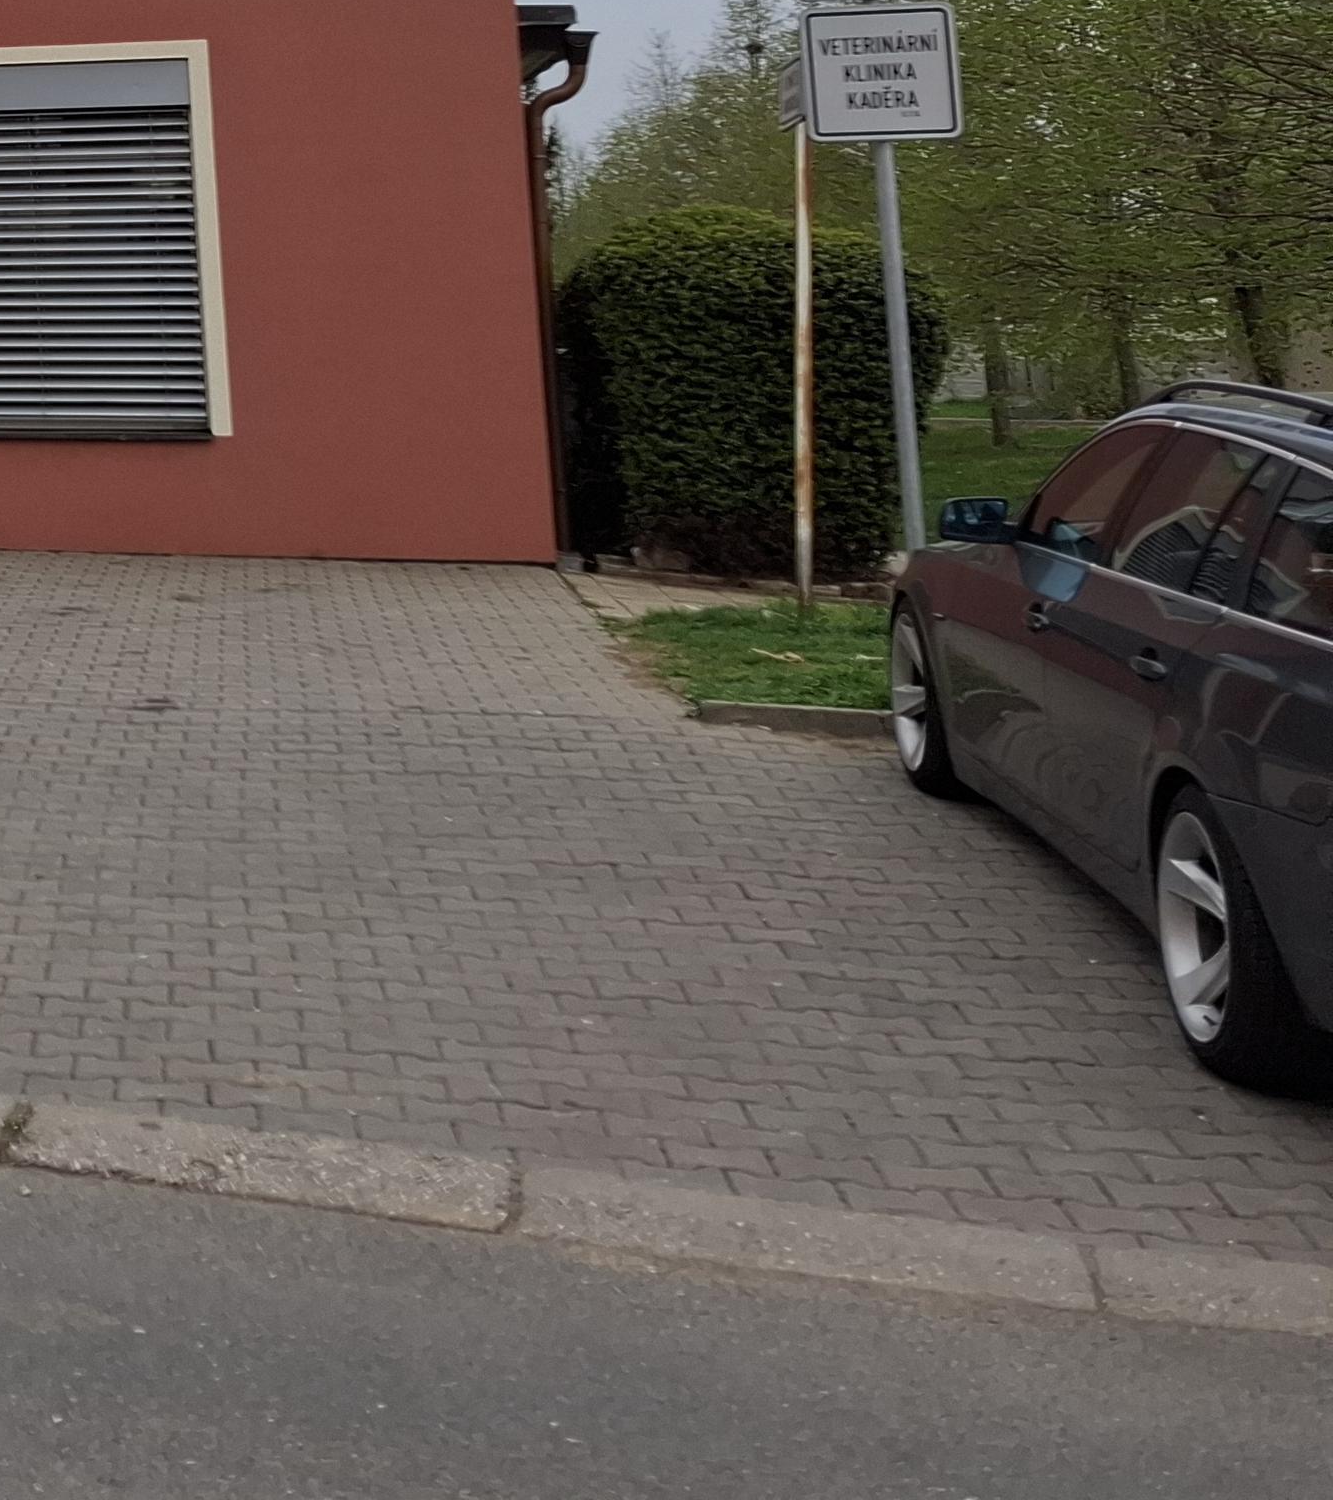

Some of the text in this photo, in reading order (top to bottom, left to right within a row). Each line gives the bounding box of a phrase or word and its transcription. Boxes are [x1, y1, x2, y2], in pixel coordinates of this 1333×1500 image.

[818, 29, 938, 56] VETERINÁRNÍ
[843, 63, 917, 82] KLINIKA
[847, 86, 920, 109] KADĚRA
